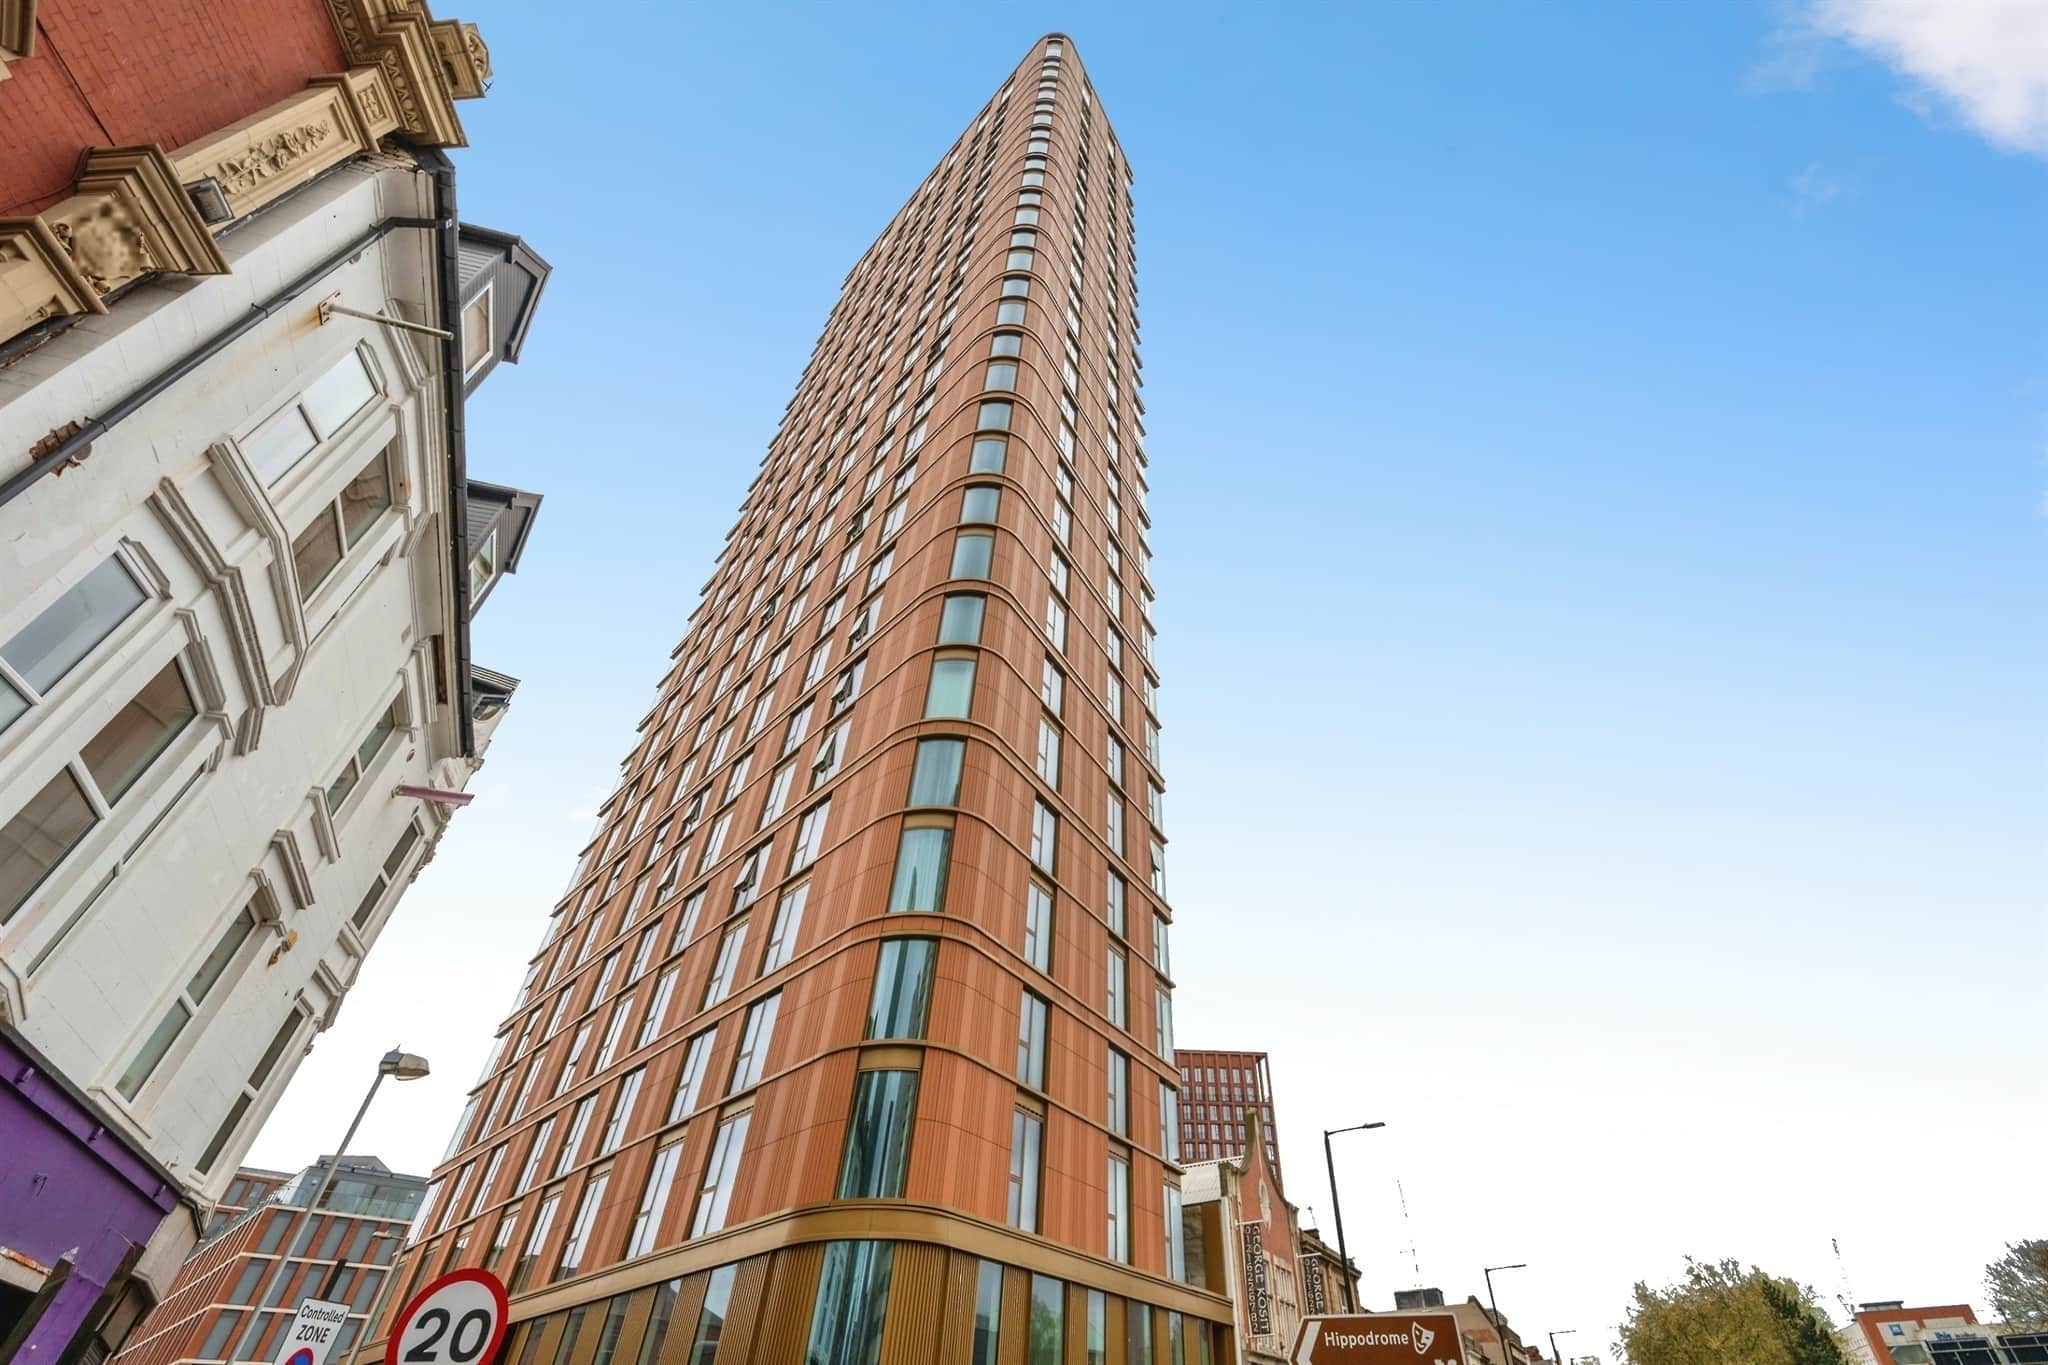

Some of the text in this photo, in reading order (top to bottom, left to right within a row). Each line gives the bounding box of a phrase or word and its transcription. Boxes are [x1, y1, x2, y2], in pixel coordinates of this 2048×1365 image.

[1252, 1225, 1264, 1283] GEORGE
[1311, 1258, 1323, 1310] GEORGE
[301, 1304, 346, 1324] Controlled
[296, 1324, 331, 1343] ZONE
[403, 1308, 491, 1362] 20
[1324, 1331, 1409, 1349] Hippodrome
